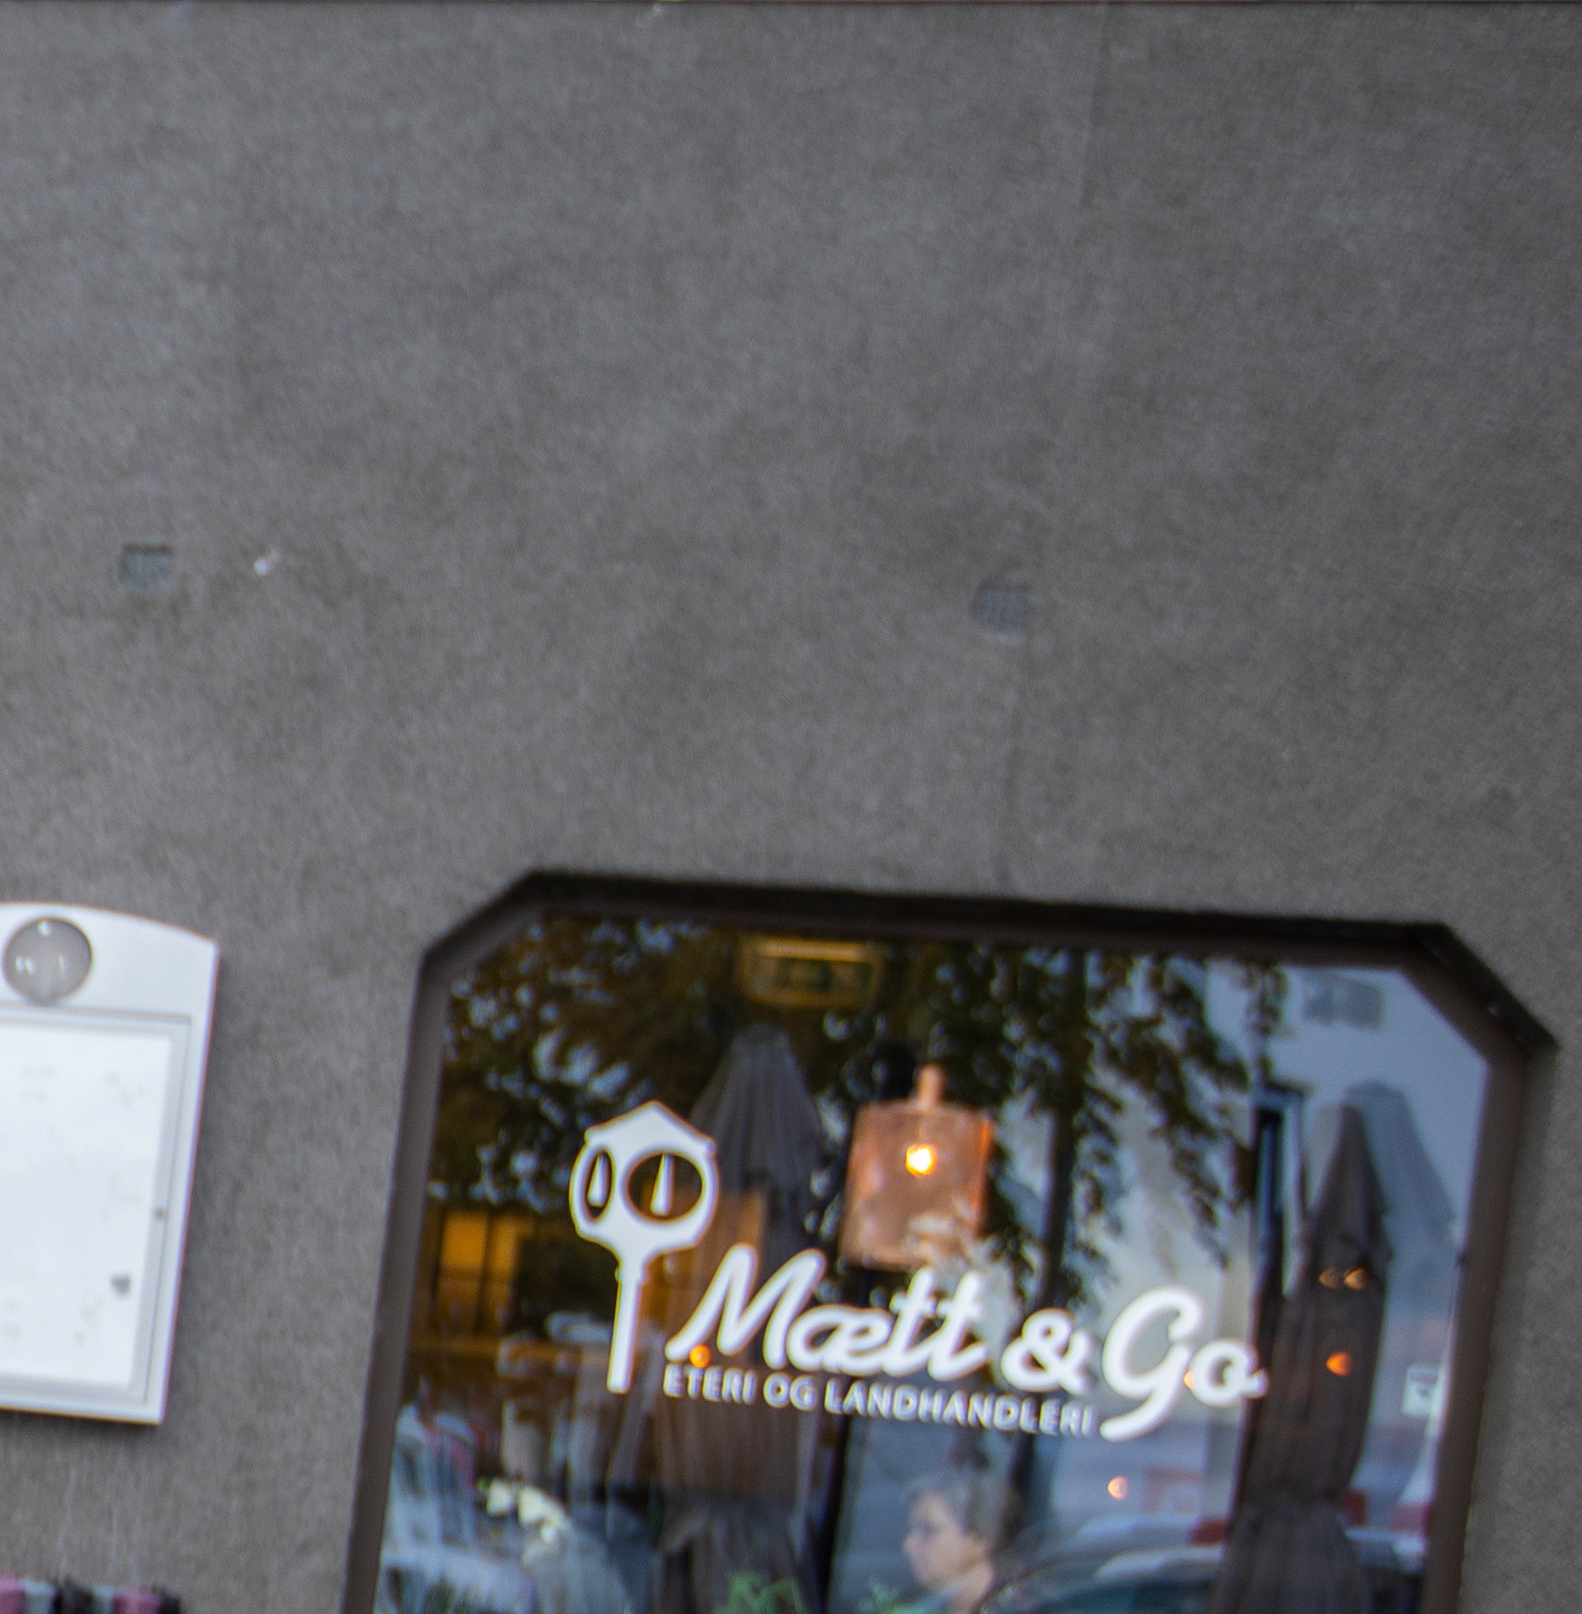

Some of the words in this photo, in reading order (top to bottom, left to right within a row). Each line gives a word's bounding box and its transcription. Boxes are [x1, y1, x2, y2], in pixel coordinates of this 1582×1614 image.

[662, 1362, 755, 1405] ETERI
[762, 1371, 817, 1412] OG
[823, 1378, 1095, 1438] LANDHANDLERI
[664, 1241, 990, 1382] Mætt
[1000, 1307, 1094, 1396] &
[1101, 1285, 1269, 1442] Go
